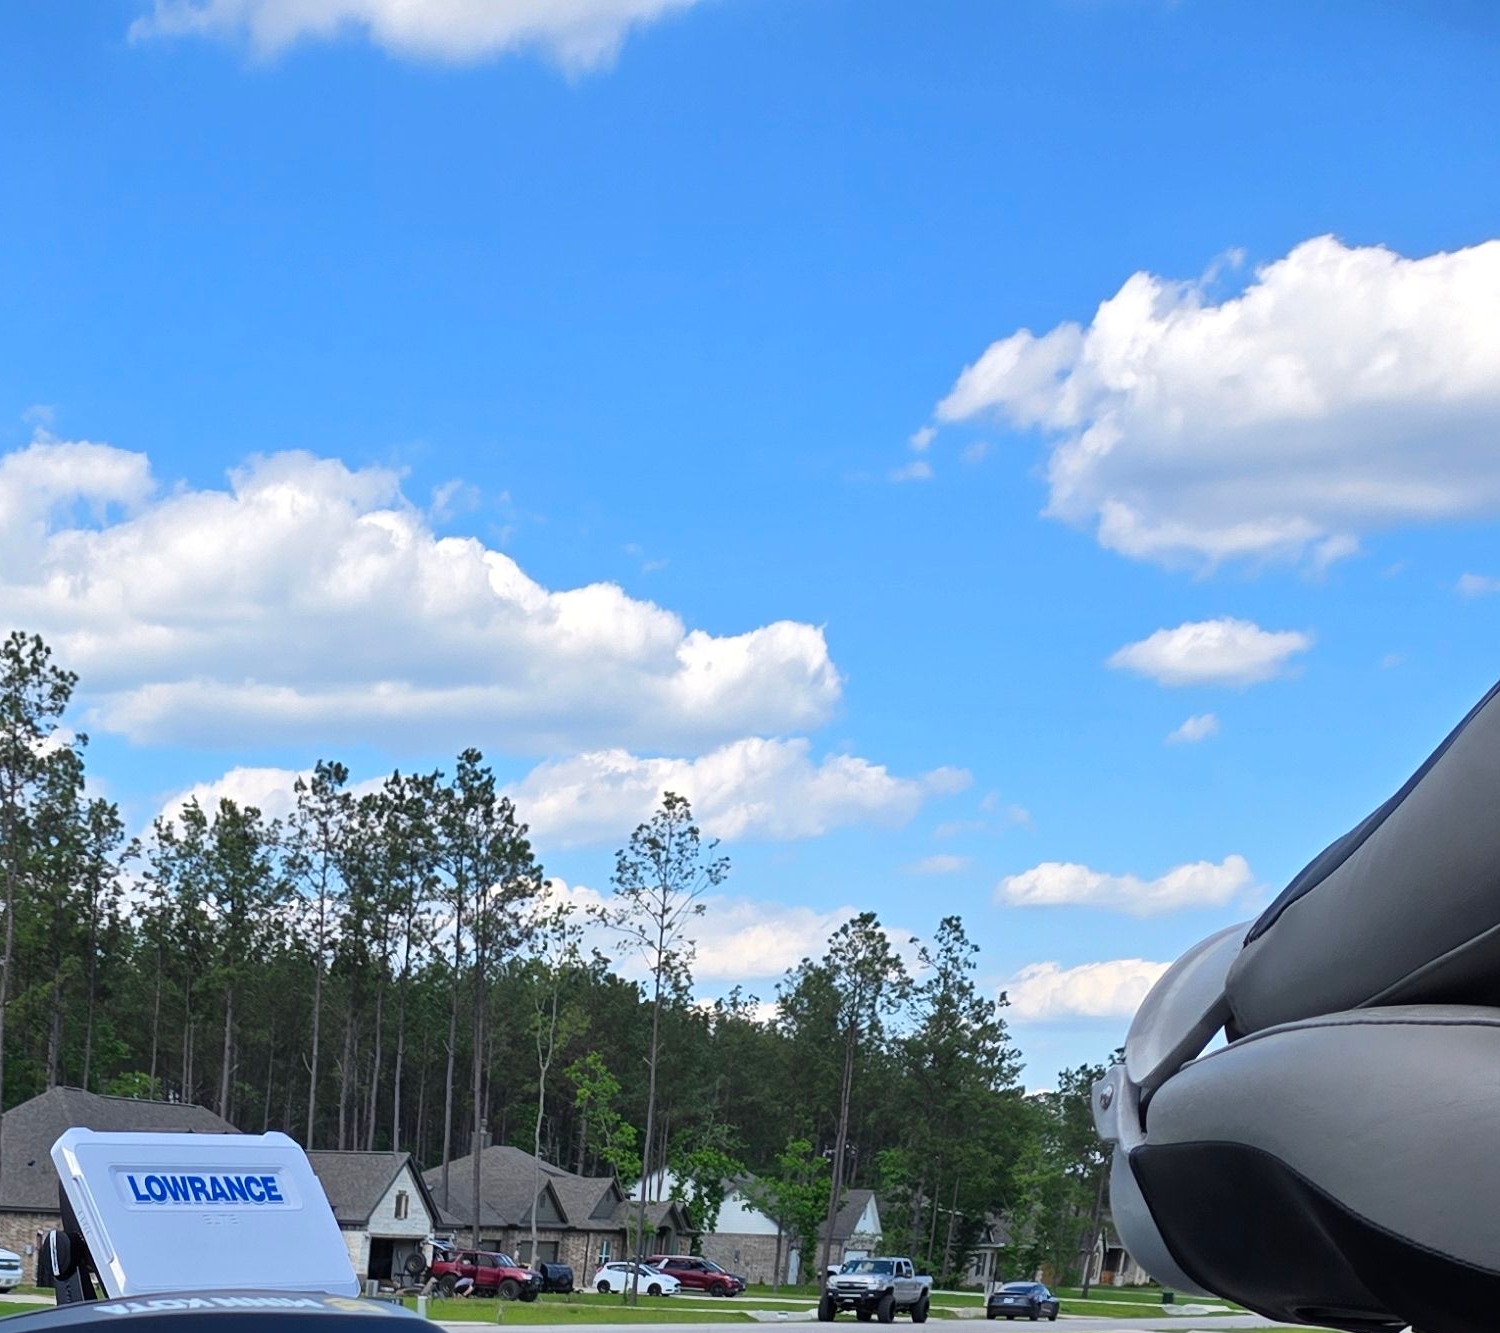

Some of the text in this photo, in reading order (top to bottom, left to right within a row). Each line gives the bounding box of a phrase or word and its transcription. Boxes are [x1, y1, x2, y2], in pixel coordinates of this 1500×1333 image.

[126, 1174, 283, 1202] LOWRANCE
[93, 1297, 324, 1315] MINN KOTA
